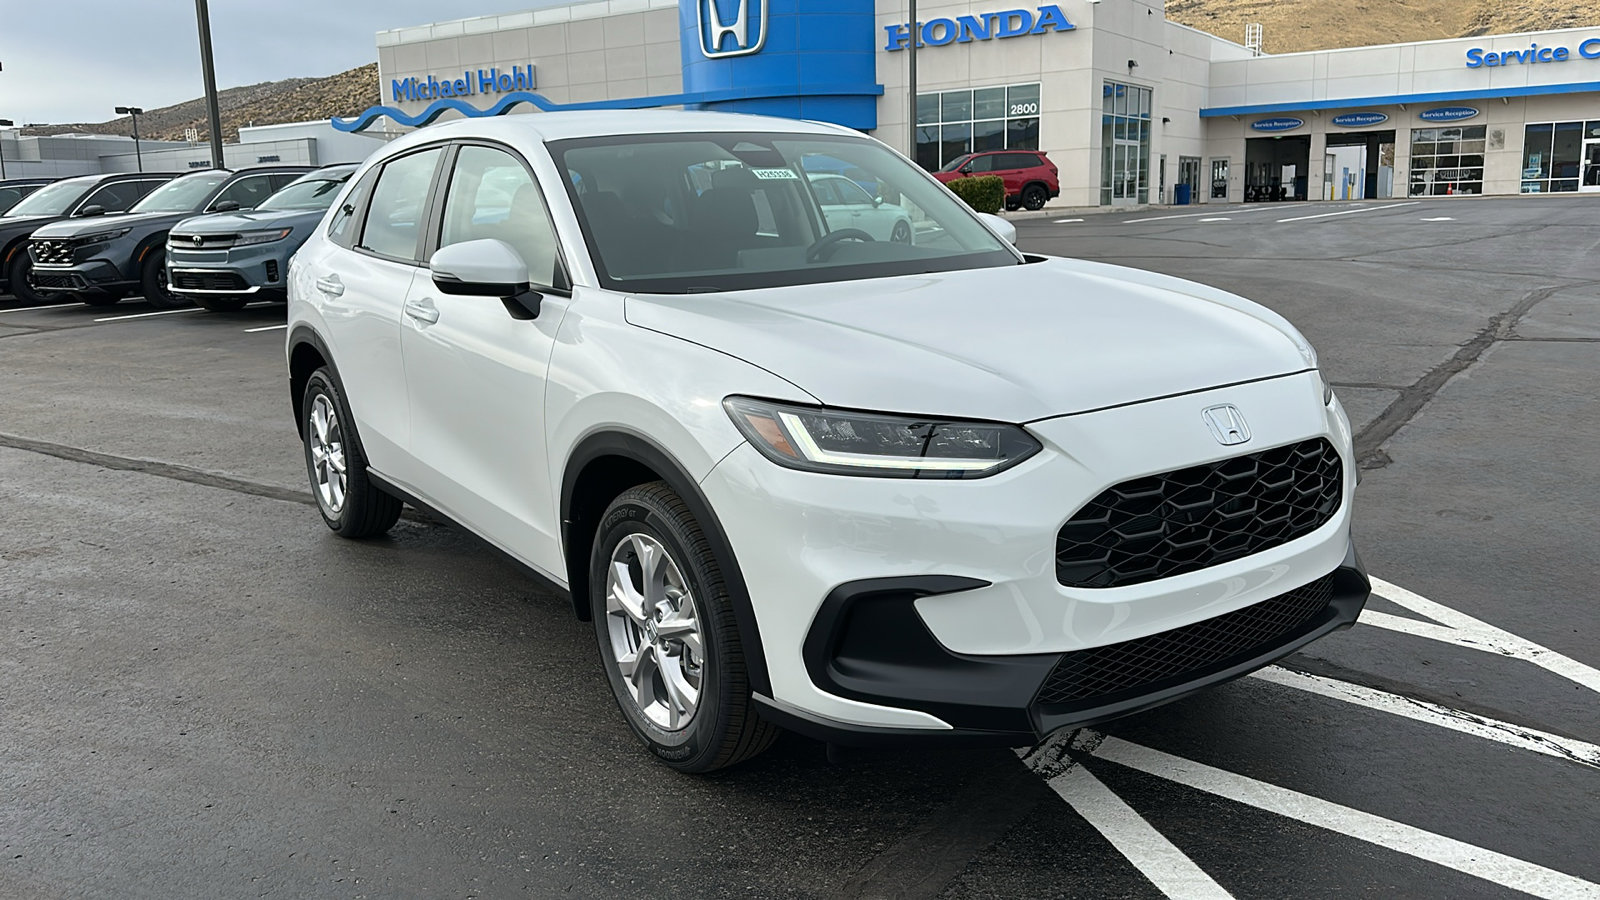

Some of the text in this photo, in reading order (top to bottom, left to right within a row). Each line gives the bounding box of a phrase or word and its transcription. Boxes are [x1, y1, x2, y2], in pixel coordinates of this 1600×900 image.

[884, 4, 1076, 51] HONDA
[1466, 43, 1569, 68] Service
[392, 64, 535, 102] Michael Hohl
[1010, 102, 1038, 115] 2800
